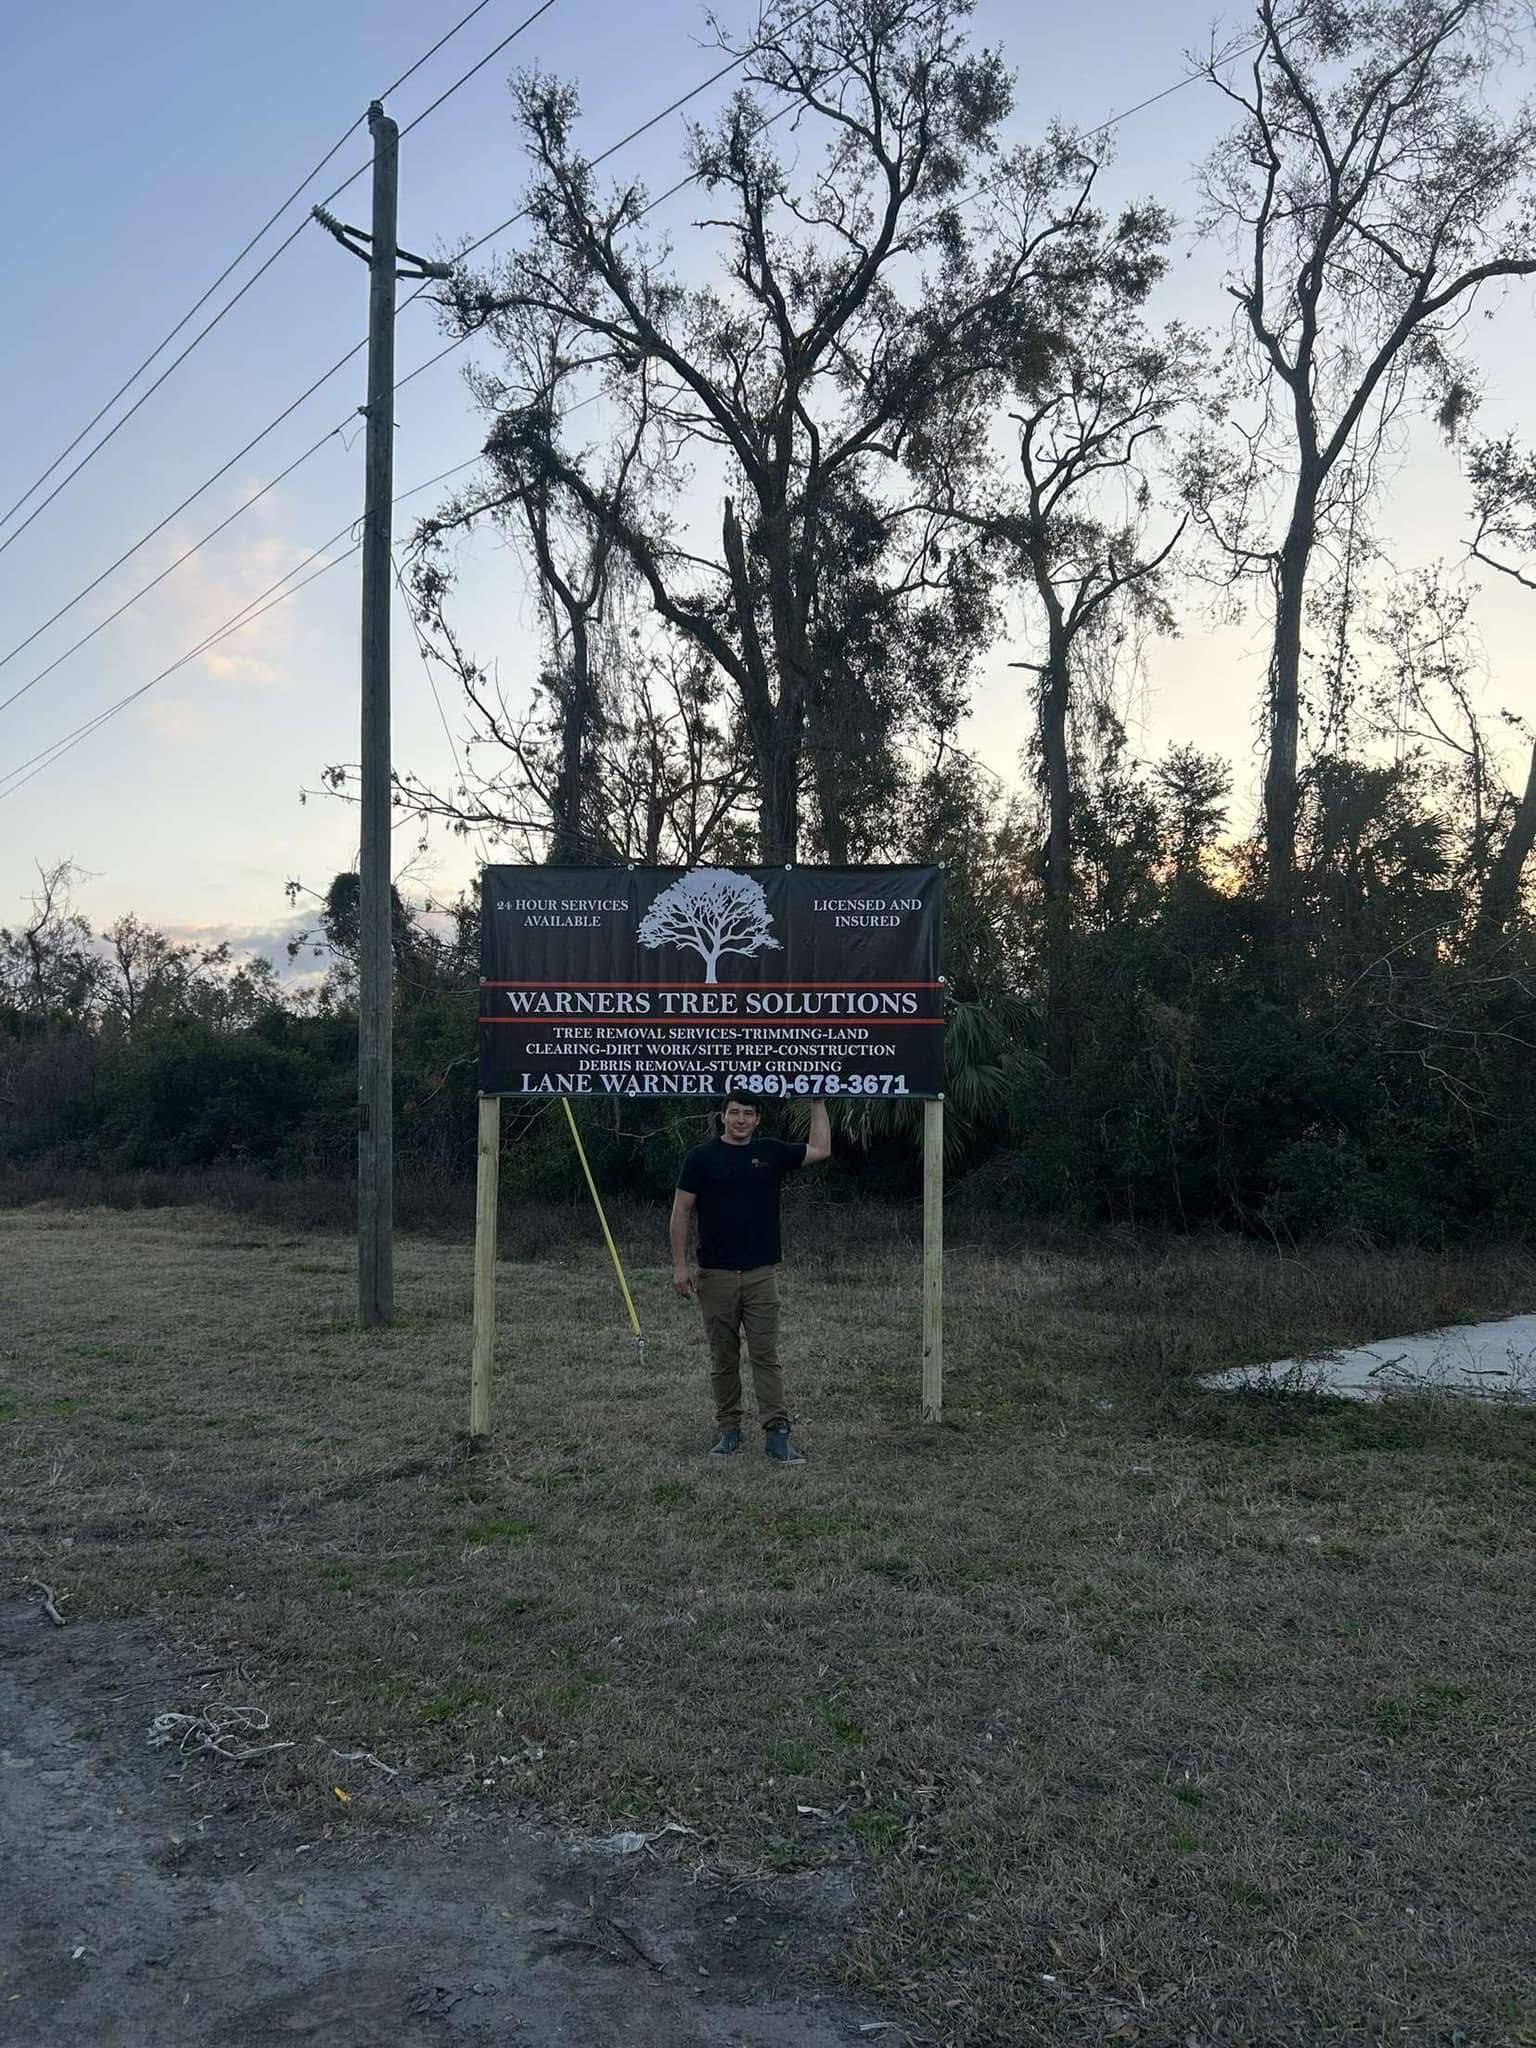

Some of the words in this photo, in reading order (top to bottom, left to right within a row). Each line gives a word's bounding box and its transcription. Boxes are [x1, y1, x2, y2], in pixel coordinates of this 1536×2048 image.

[497, 901, 513, 911] 24
[515, 899, 557, 911] HOUR
[561, 900, 629, 911] SERVICES
[814, 899, 886, 911] LICENSED
[890, 899, 922, 911] AND
[523, 915, 601, 927] AVAILABLE
[835, 916, 901, 927] INSURED
[506, 991, 650, 1014] WARNERS
[658, 992, 738, 1014] TREE
[746, 992, 918, 1014] SOLUTIONS
[553, 1027, 593, 1039] TREE
[596, 1027, 666, 1039] REMOVAL
[668, 1028, 869, 1040] SERVICES-TRIMMING-LAND
[525, 1043, 643, 1055] CLEARING-DIRT
[646, 1043, 732, 1056] WORK/SITE
[736, 1044, 896, 1056] PREP-CONSTRUCTION
[578, 1059, 632, 1071] DEBRIS
[635, 1060, 762, 1072] REMOVAL-STUMP
[765, 1061, 842, 1072] GRINDING
[520, 1073, 593, 1093] LANE
[599, 1074, 715, 1094] WARNER
[725, 1074, 909, 1097] (386)-678-3671
